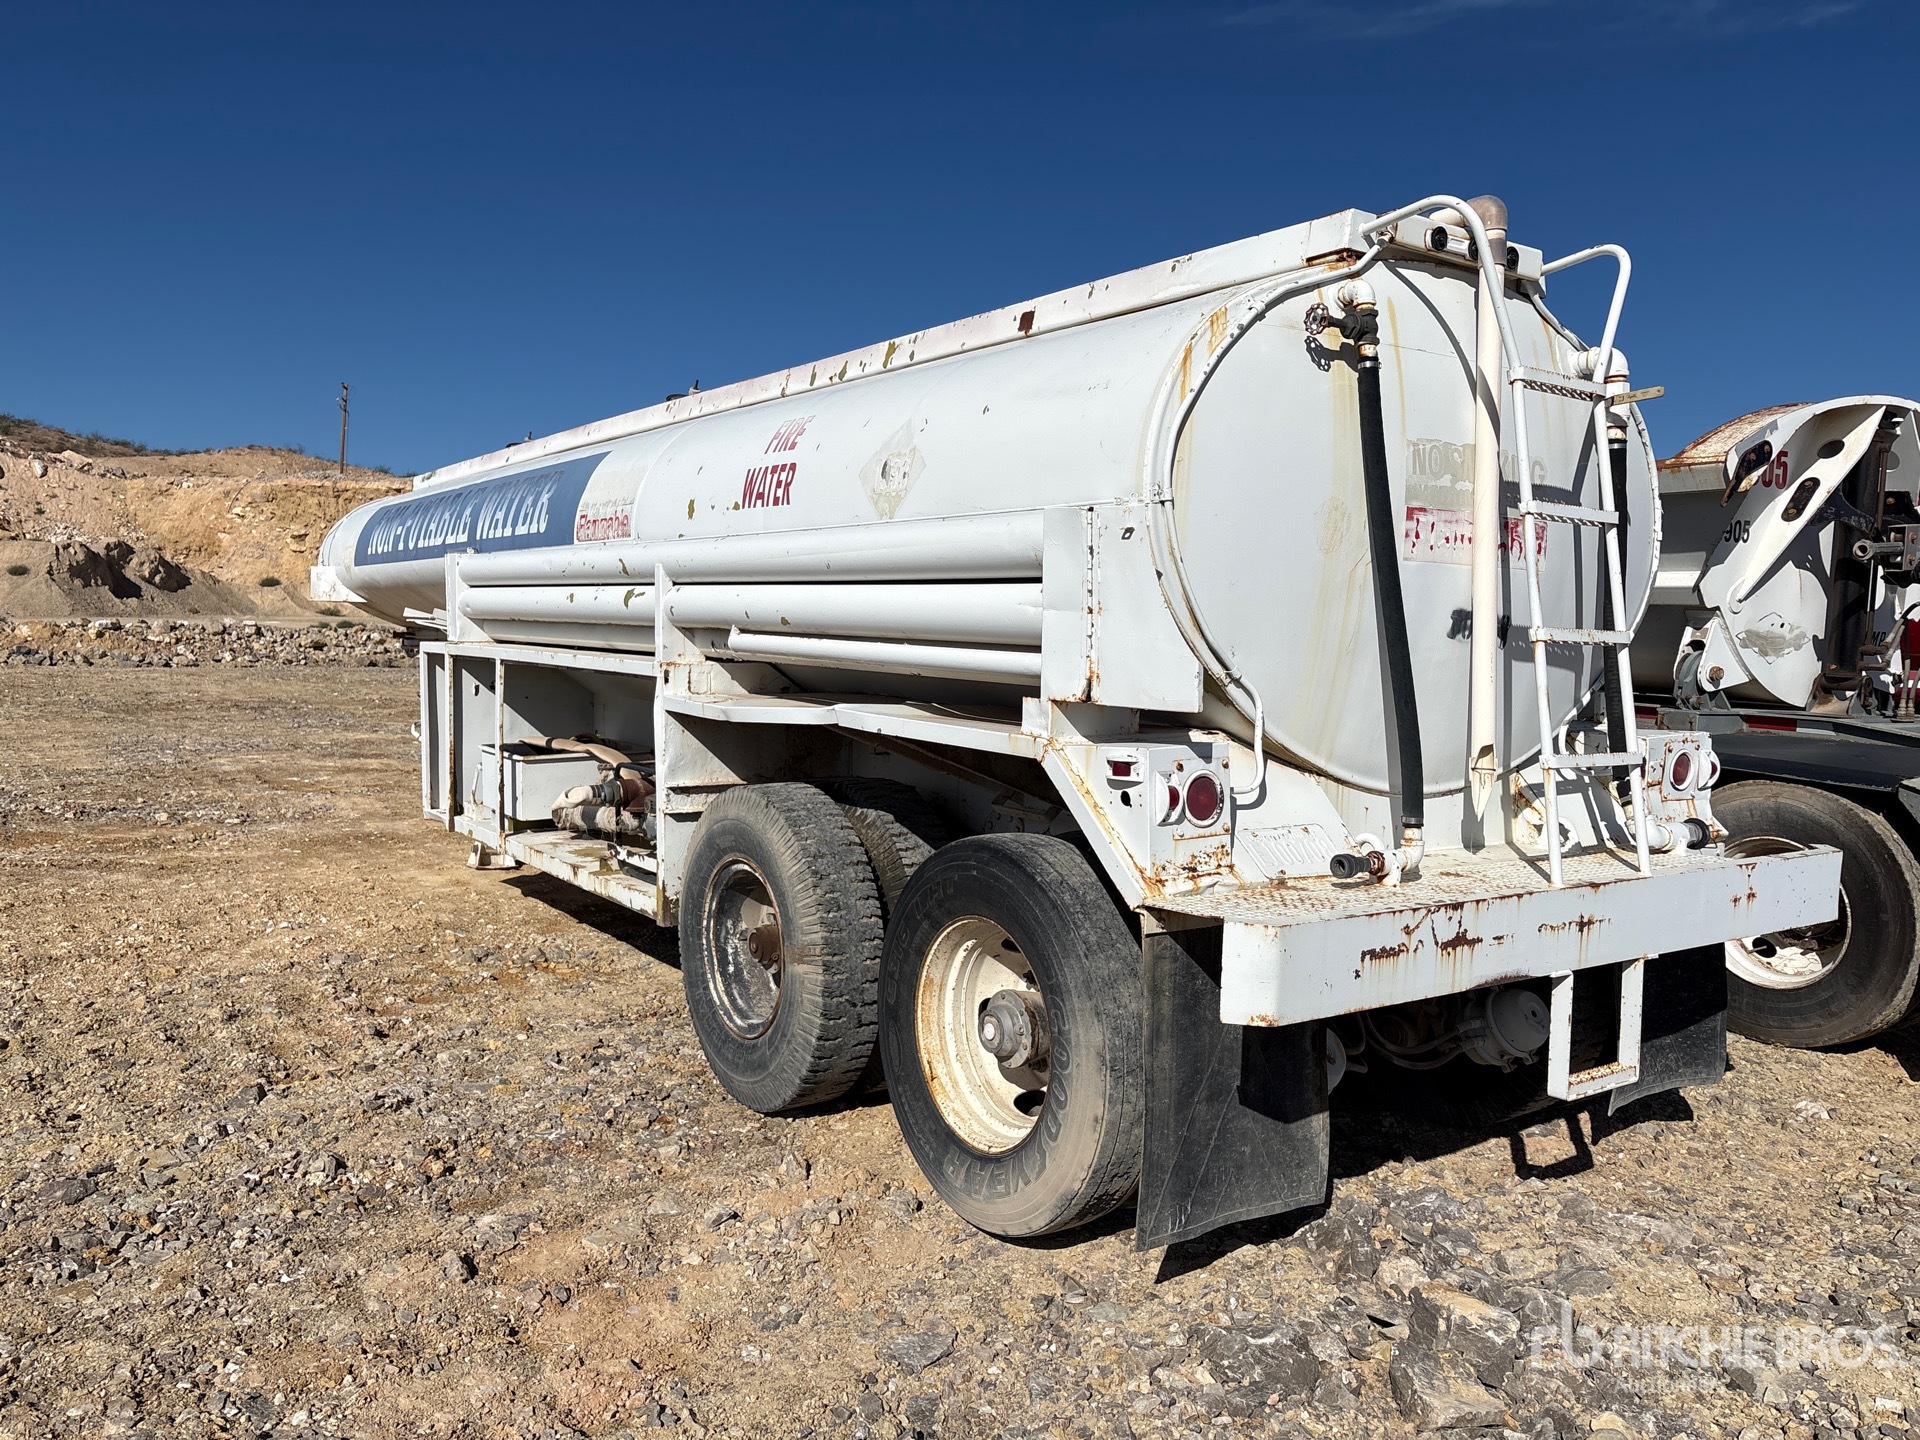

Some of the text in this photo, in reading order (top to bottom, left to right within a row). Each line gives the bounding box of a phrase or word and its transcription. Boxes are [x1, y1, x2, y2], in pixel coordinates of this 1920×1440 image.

[764, 415, 816, 454] FIRE
[742, 462, 797, 509] WATER
[1753, 450, 1788, 489] 05
[367, 470, 565, 555] NON-POTABLE WATER
[943, 995, 1071, 1199] GOODYEAR
